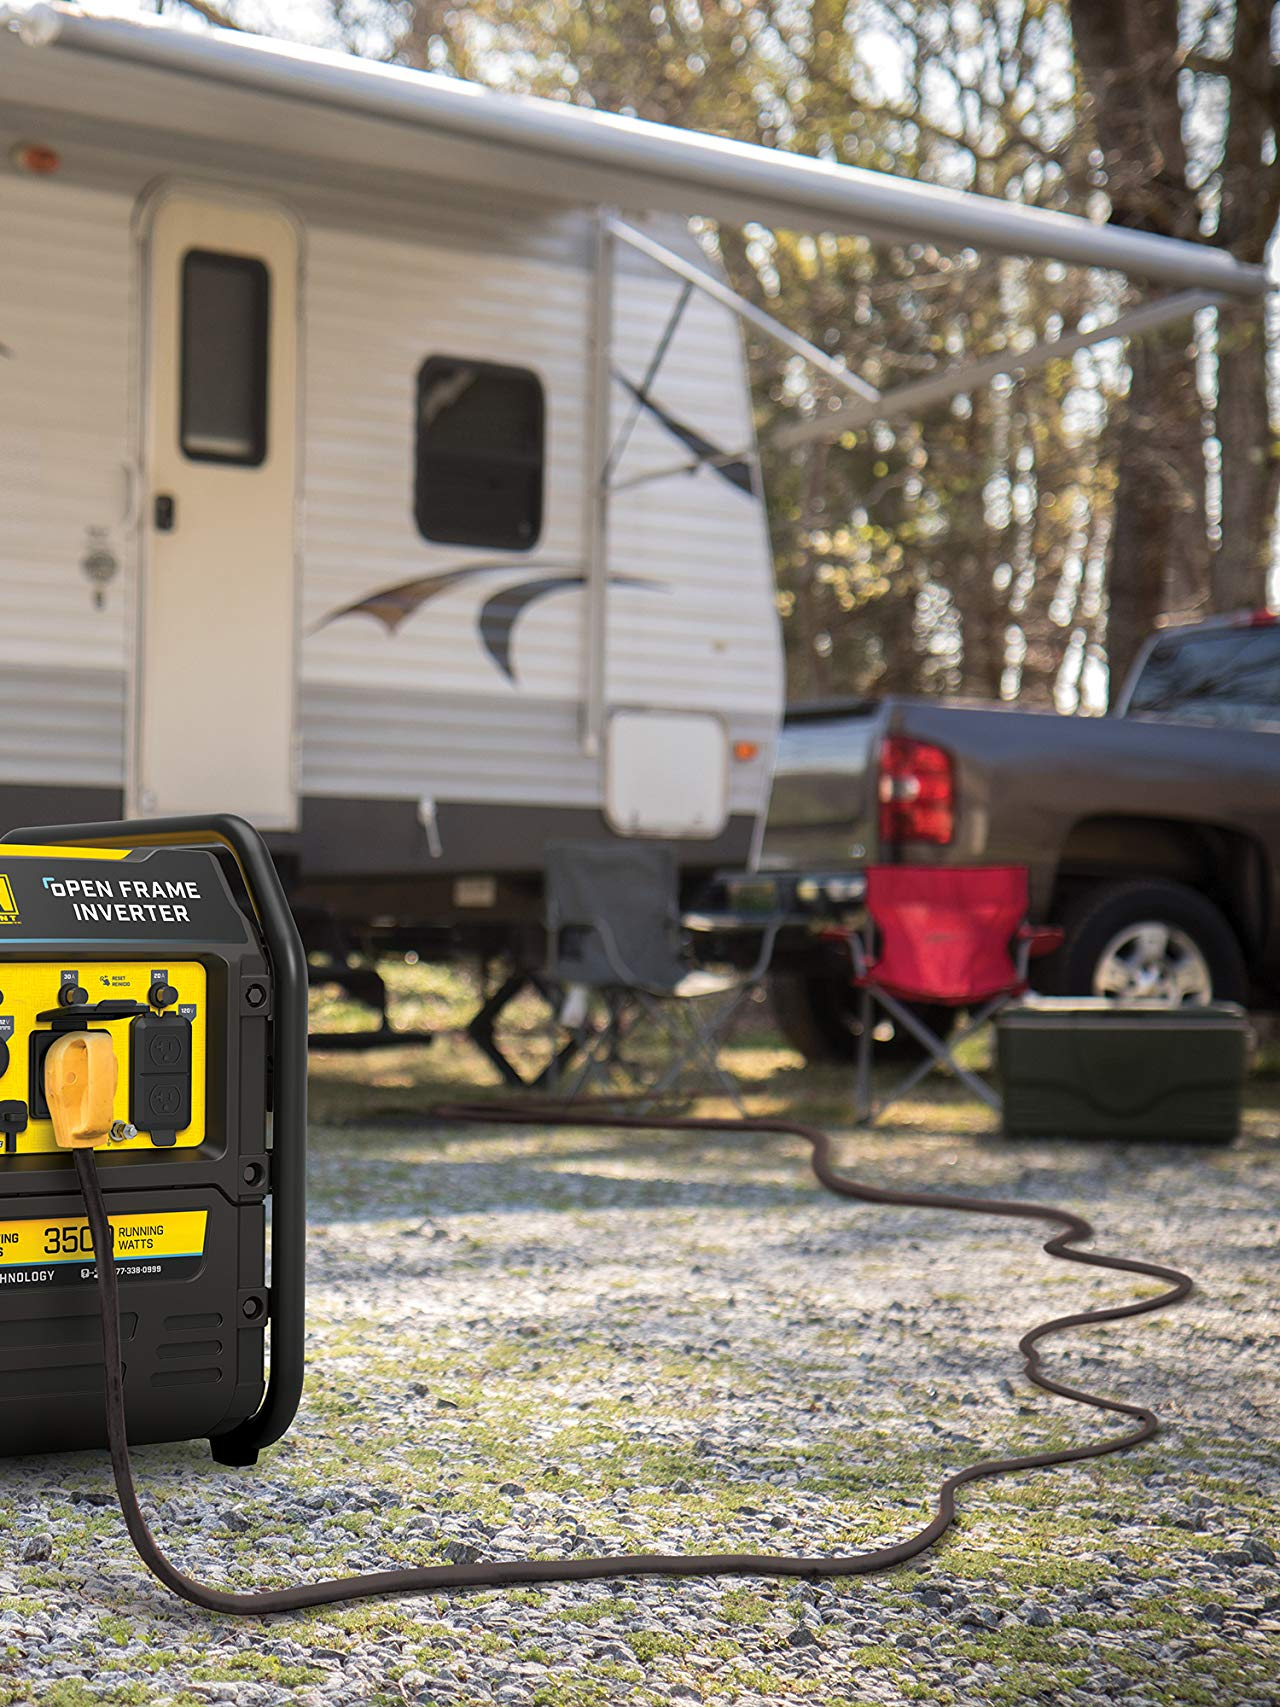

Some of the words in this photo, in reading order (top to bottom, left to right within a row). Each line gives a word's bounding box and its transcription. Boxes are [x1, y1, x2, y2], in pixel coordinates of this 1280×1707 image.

[50, 879, 114, 898] OPEN
[118, 881, 201, 899] FRAME
[72, 903, 191, 922] INVERTER
[118, 1225, 164, 1238] RUNNING
[118, 1238, 154, 1251] WATTS
